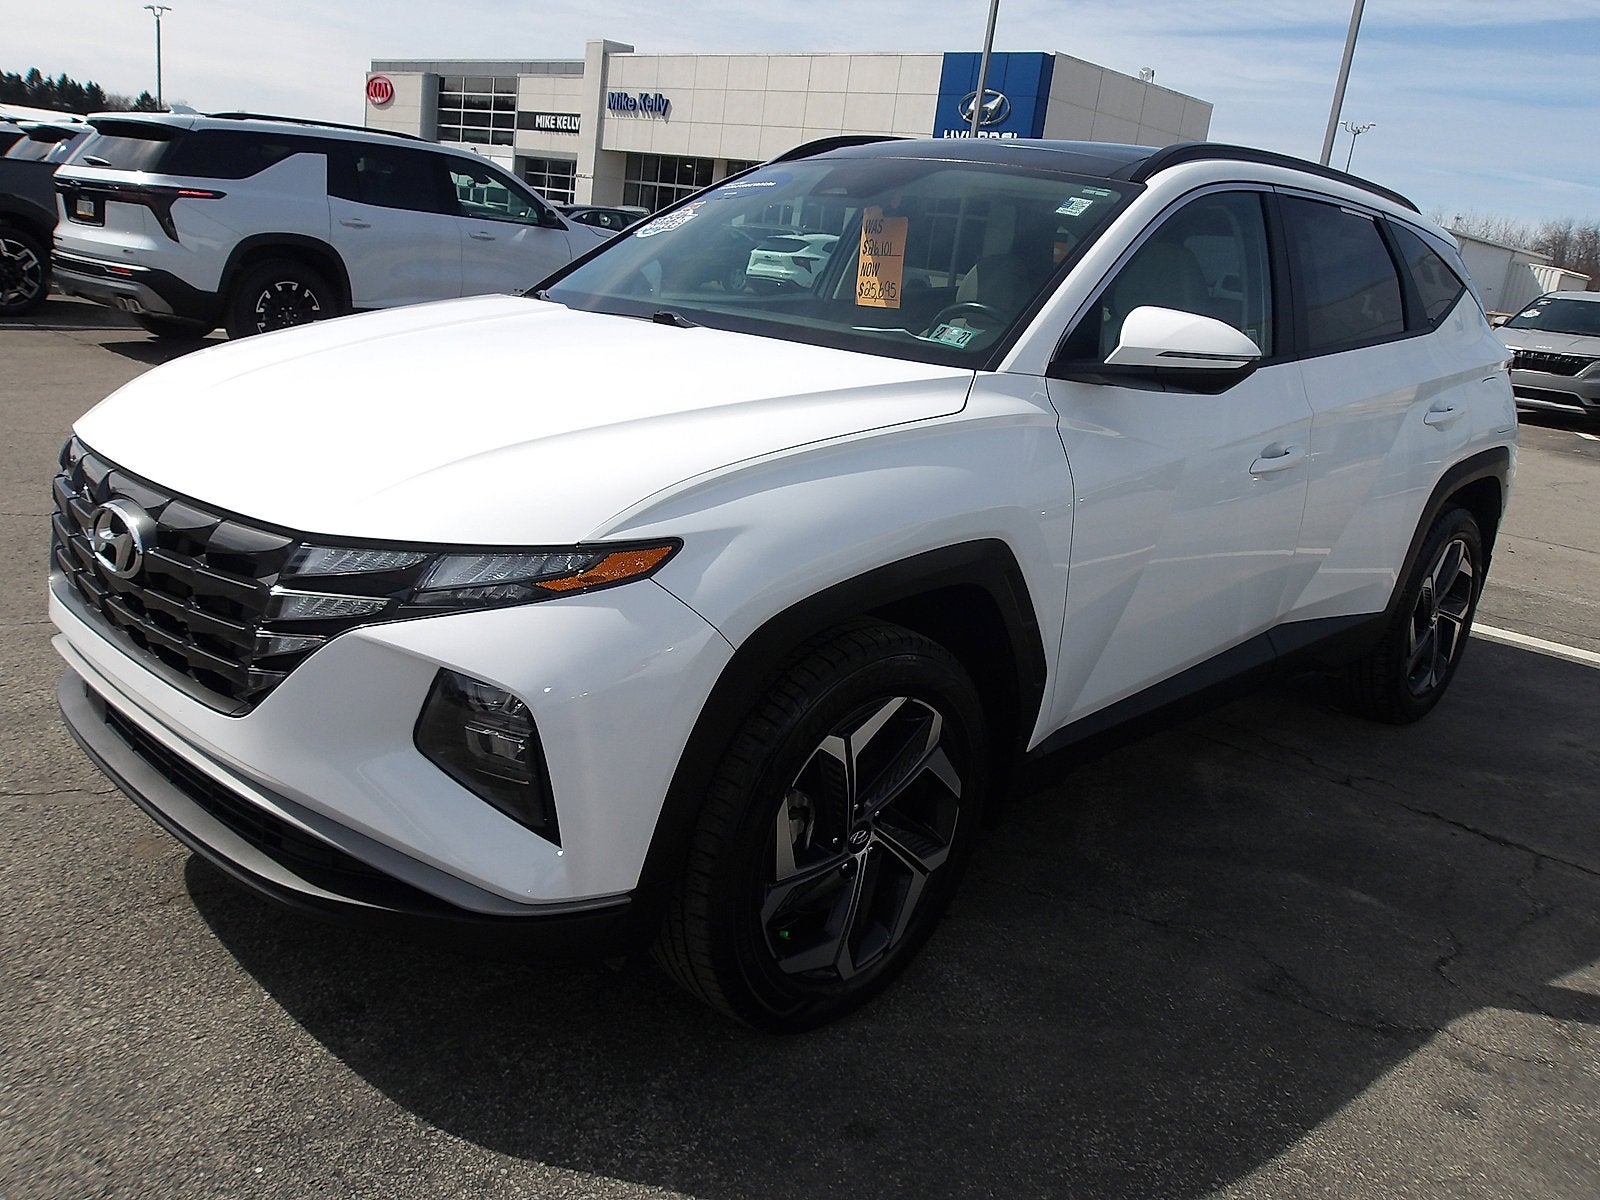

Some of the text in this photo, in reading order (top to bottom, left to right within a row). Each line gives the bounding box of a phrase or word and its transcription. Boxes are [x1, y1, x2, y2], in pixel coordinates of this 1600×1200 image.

[369, 81, 388, 97] KIA
[608, 92, 669, 116] Mike Kelly
[535, 114, 581, 130] MIKE KELLY
[865, 219, 883, 234] WAS
[860, 262, 880, 278] NOW
